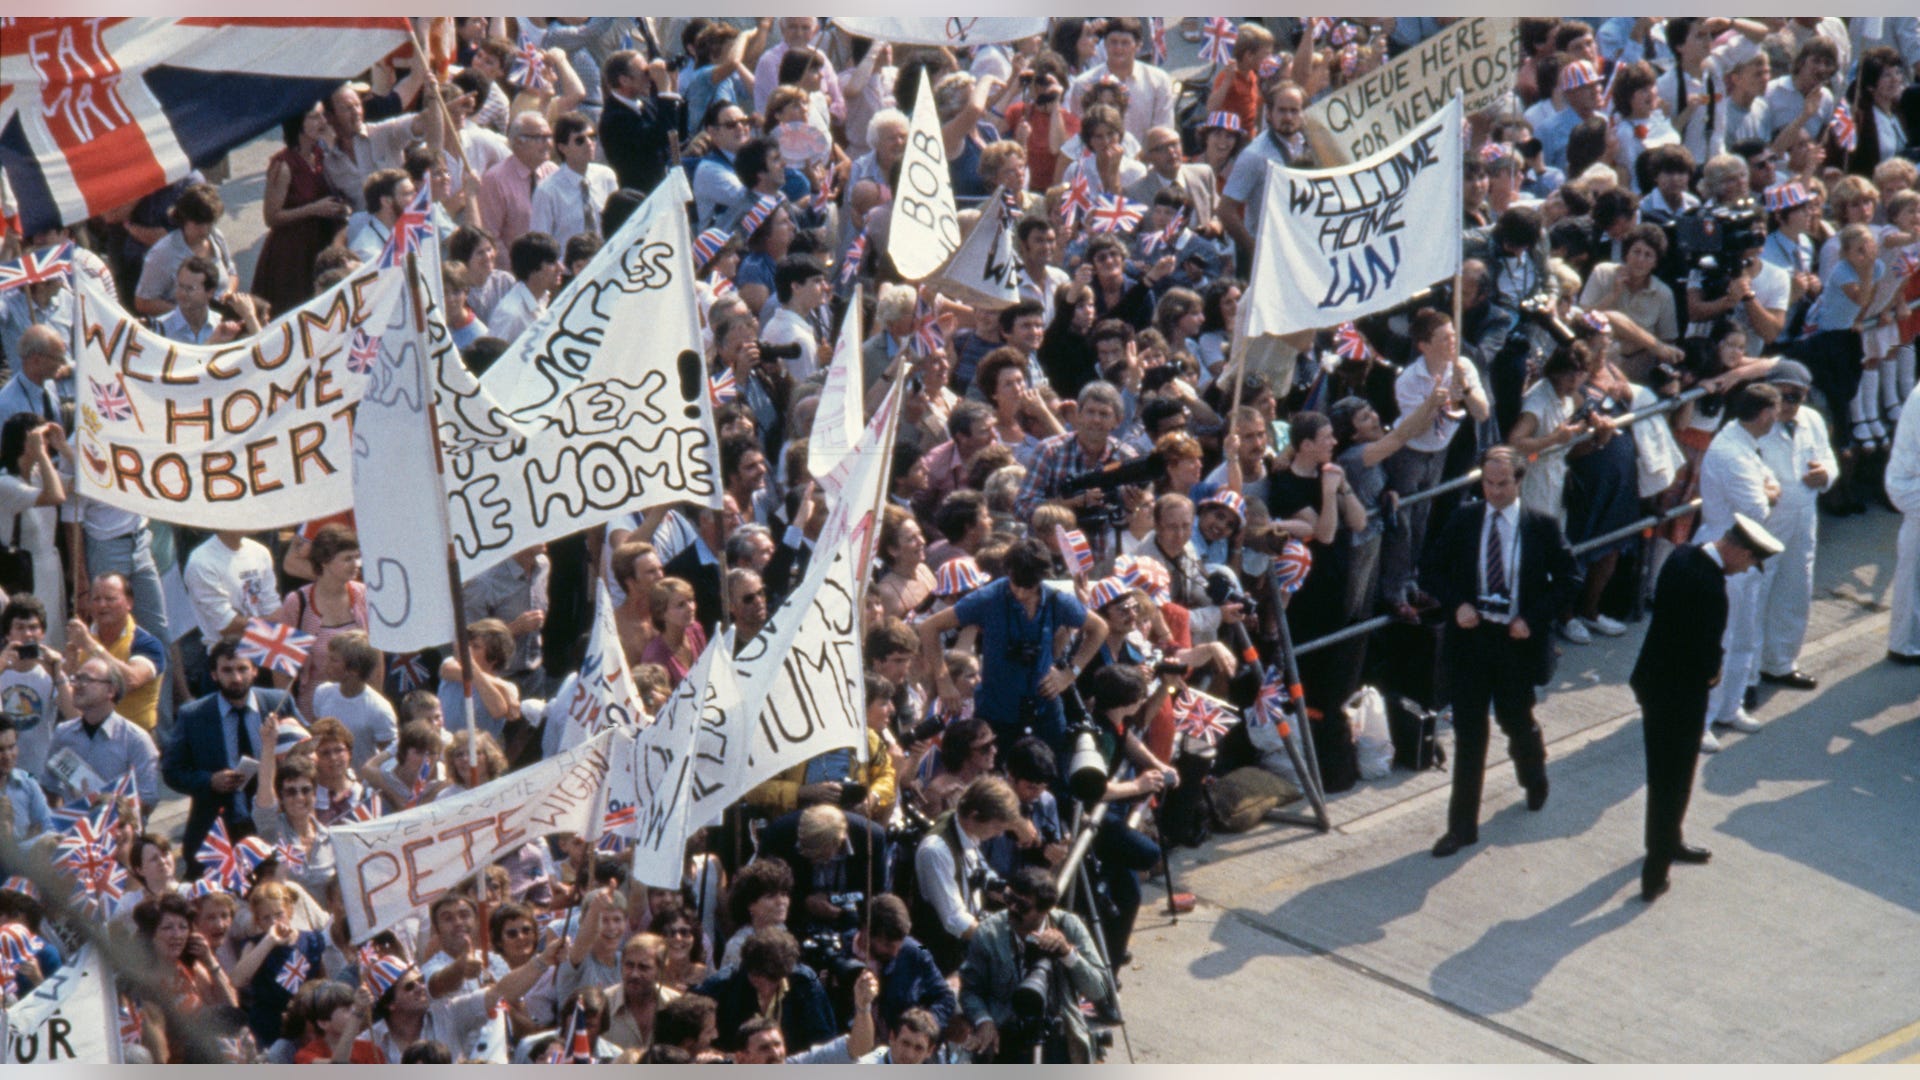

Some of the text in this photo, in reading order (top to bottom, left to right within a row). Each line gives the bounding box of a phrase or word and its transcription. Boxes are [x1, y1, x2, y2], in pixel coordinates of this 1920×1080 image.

[28, 16, 114, 84] FAT
[1326, 60, 1411, 133] QUEUE
[1421, 17, 1487, 77] HERE
[901, 129, 942, 230] BOB
[1289, 125, 1443, 217] WELCOME
[1351, 122, 1389, 161] FOR
[1318, 199, 1405, 255] HOME
[1318, 235, 1401, 309] IAN
[165, 347, 345, 445] HOME
[524, 426, 715, 528] HOME
[357, 804, 527, 929] PETE
[529, 749, 610, 826] WIGAN
